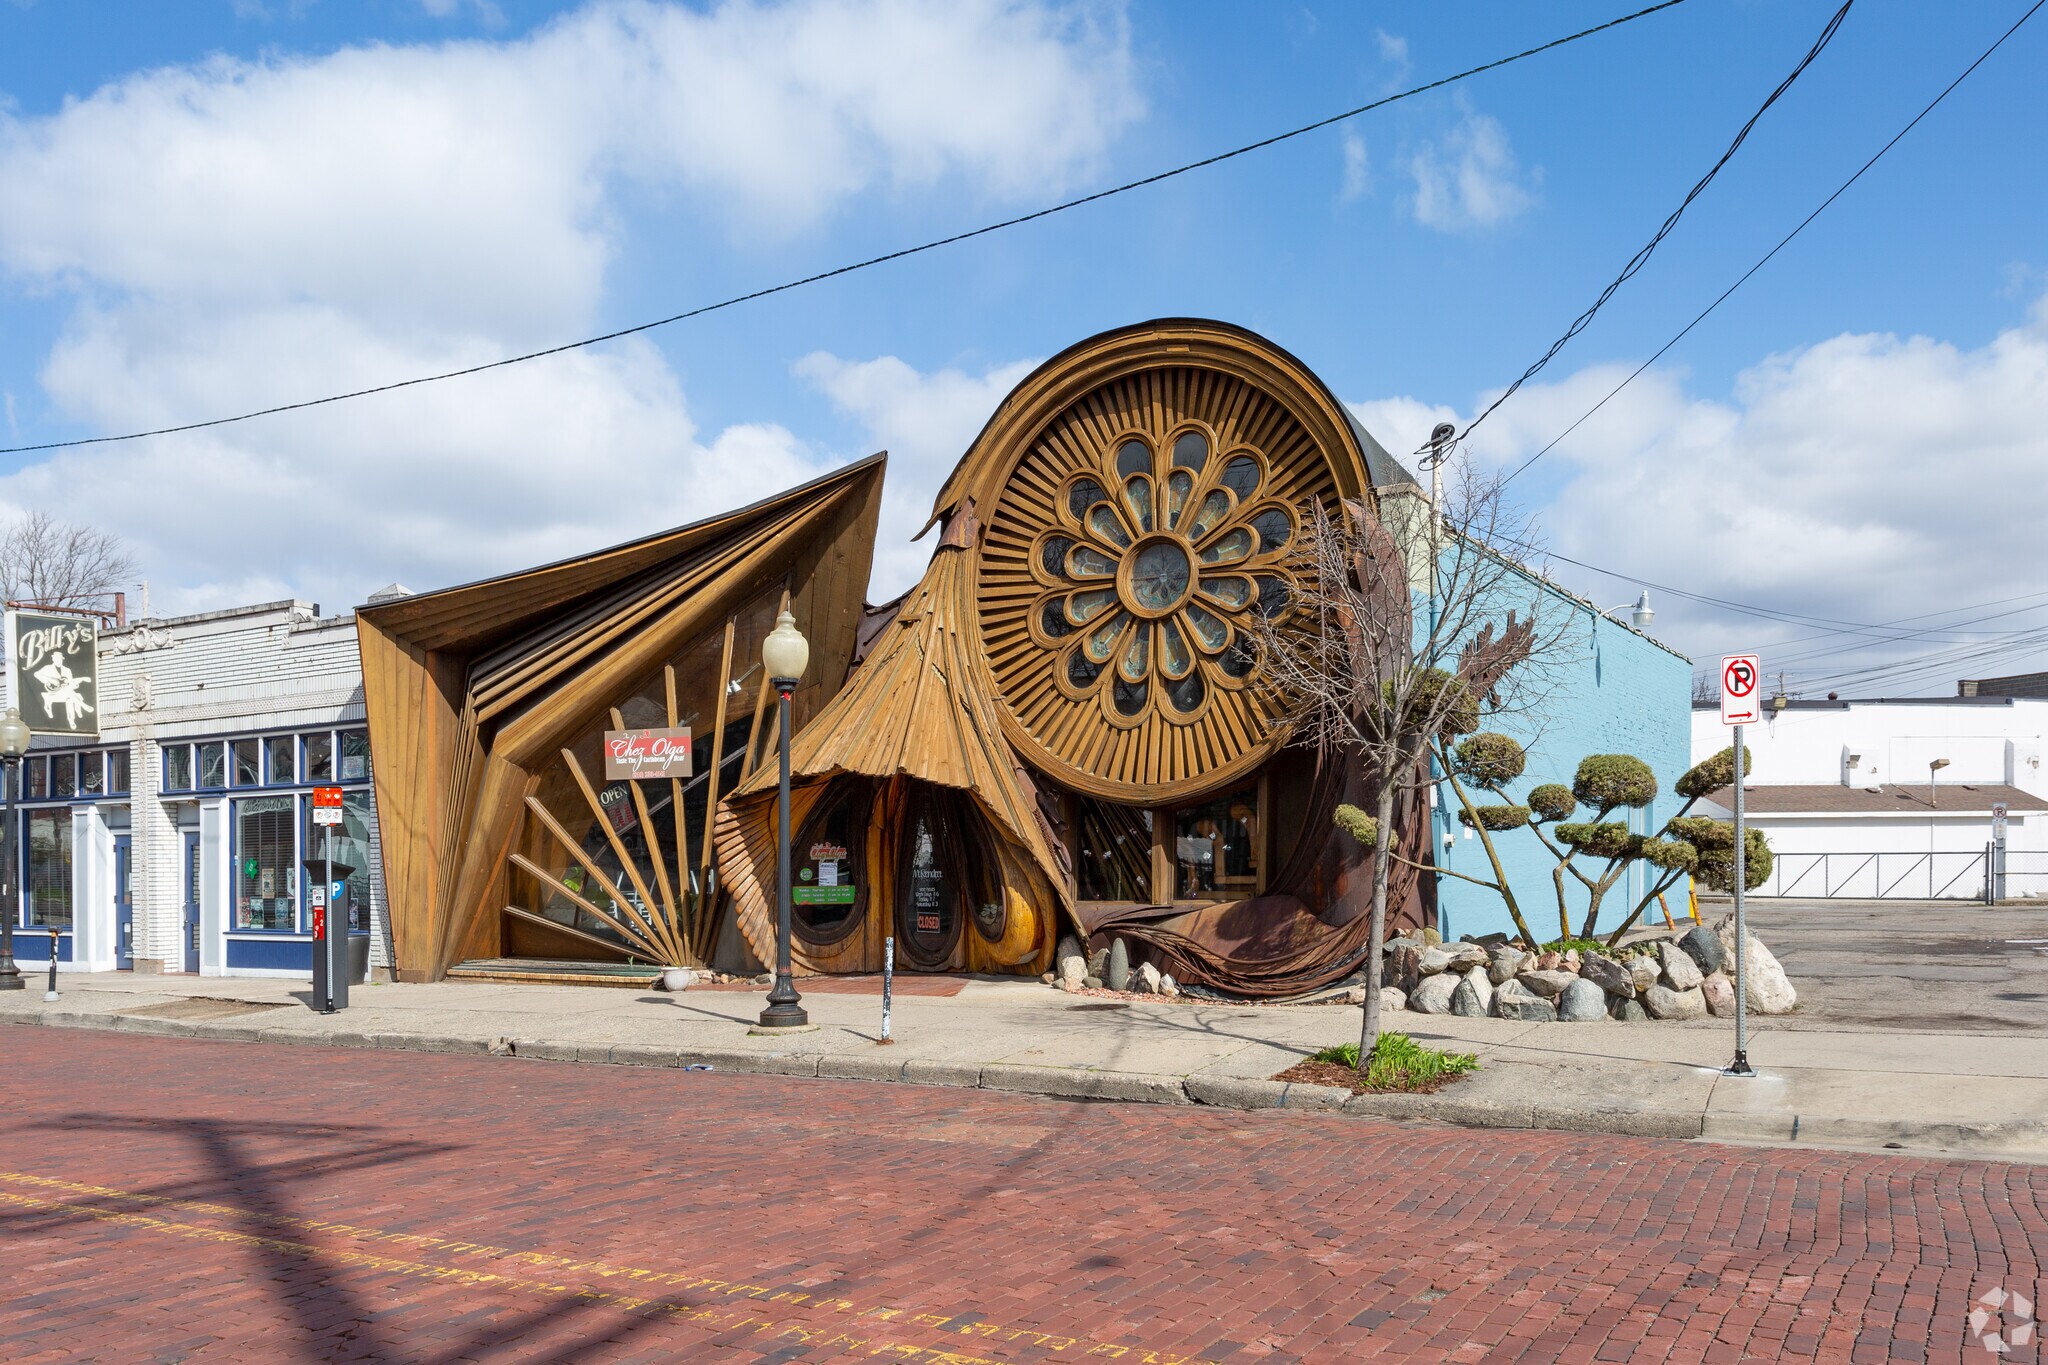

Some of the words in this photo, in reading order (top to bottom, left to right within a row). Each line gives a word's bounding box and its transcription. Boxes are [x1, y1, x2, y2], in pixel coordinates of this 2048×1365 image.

[19, 622, 93, 671] Billy's
[611, 735, 645, 772] Chez
[652, 737, 685, 771] Olga
[600, 783, 628, 804] OPEN
[332, 882, 341, 897] P
[918, 915, 939, 929] CLOSED
